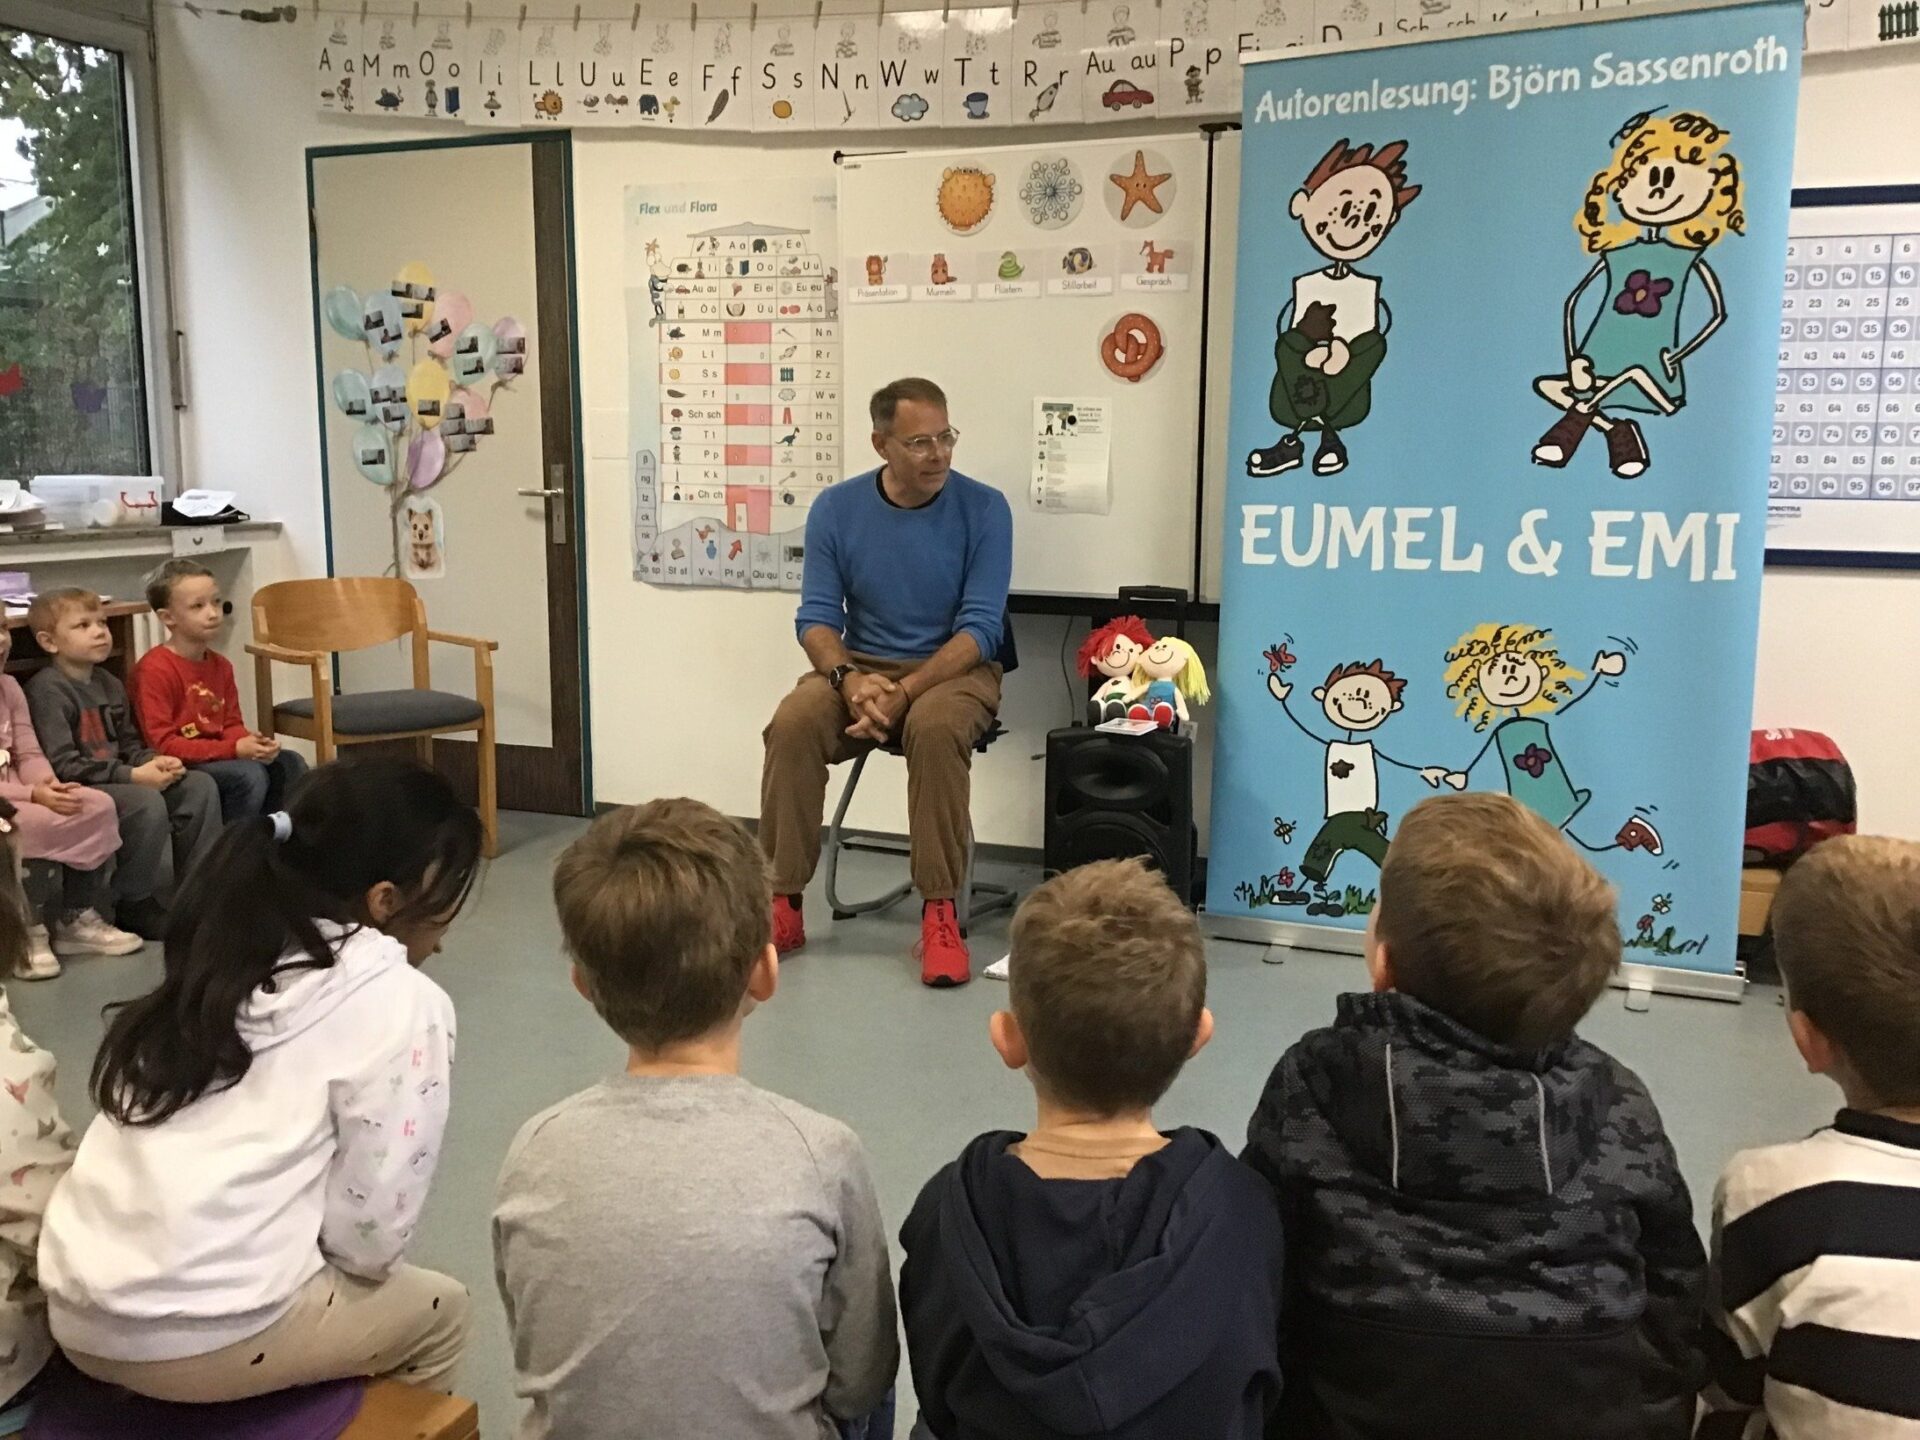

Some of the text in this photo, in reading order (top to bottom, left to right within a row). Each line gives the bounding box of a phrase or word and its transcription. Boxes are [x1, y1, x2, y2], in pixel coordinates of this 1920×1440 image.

[319, 48, 354, 72] A a
[363, 54, 410, 78] M m
[420, 51, 460, 77] O o
[1086, 52, 1156, 75] Au au
[1170, 38, 1221, 75] P p
[530, 61, 540, 85] L
[581, 62, 625, 86] U u
[641, 59, 678, 86] E e
[704, 65, 741, 96] F f
[762, 63, 802, 89] S s
[822, 63, 868, 89] N n
[881, 59, 939, 87] W w
[954, 58, 999, 86] T t
[1025, 61, 1068, 86] R r
[1255, 35, 1788, 123] Autorenlesung: Björn Sassenroth
[639, 201, 717, 215] Flex und Flora
[1787, 247, 1794, 256] 2
[1816, 246, 1823, 255] 3
[1874, 245, 1881, 253] 5
[1904, 244, 1910, 252] 6
[1062, 279, 1097, 291] Stillarbeit
[1813, 273, 1823, 281] 13
[1841, 272, 1852, 280] 14
[1871, 271, 1881, 280] 15
[1900, 271, 1910, 279] 16
[926, 287, 957, 298] Murmeln
[1809, 299, 1821, 308] 23
[1837, 299, 1850, 307] 24
[1866, 298, 1879, 307] 25
[1896, 297, 1909, 306] 26
[1807, 324, 1906, 334] 33 34 35 36
[1804, 352, 1817, 360] 43
[1861, 351, 1875, 360] 45
[1891, 351, 1904, 359] 46
[1802, 378, 1815, 386] 53
[1831, 378, 1844, 386] 54
[1859, 378, 1872, 387] 55
[1888, 377, 1901, 386] 56
[1800, 404, 1899, 412] 63 64 65 66
[1799, 430, 1897, 438] 73 74 75 76
[1796, 455, 1894, 465] 83 84 85 86
[1794, 481, 1892, 491] 93 94 95 96
[1240, 503, 1741, 582] EUMEL & EMI
